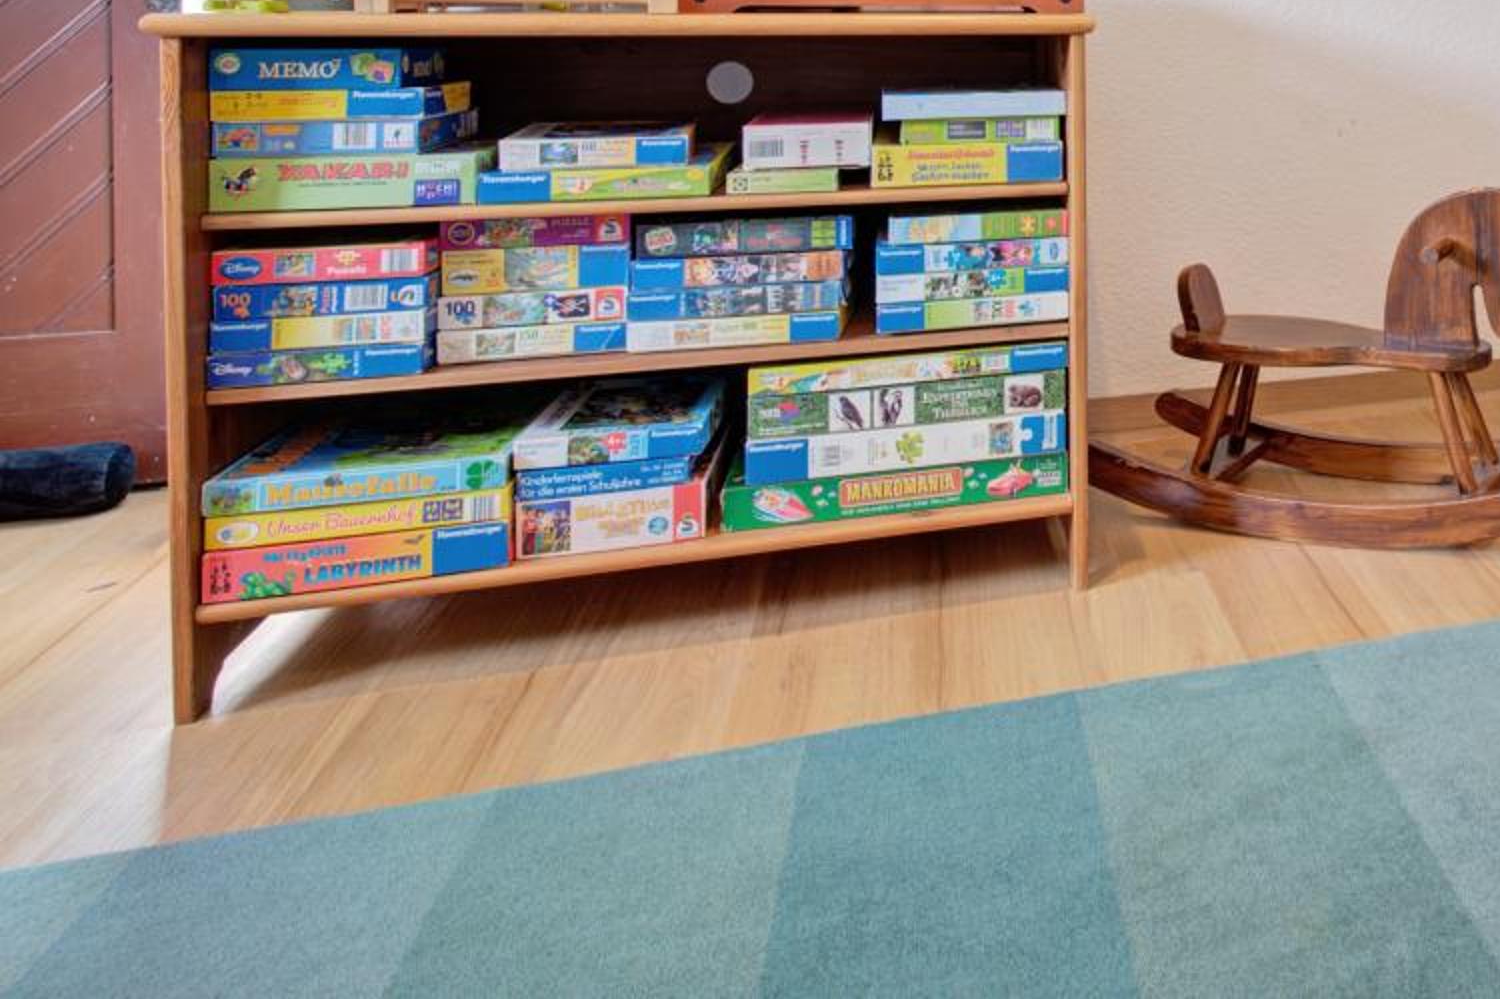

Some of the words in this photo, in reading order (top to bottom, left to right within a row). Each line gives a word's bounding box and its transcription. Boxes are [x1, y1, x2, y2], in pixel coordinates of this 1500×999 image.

[220, 293, 251, 308] 100
[446, 301, 476, 316] 100
[847, 472, 956, 502] MANKOMANIA
[304, 554, 423, 585] LABYRINTH
